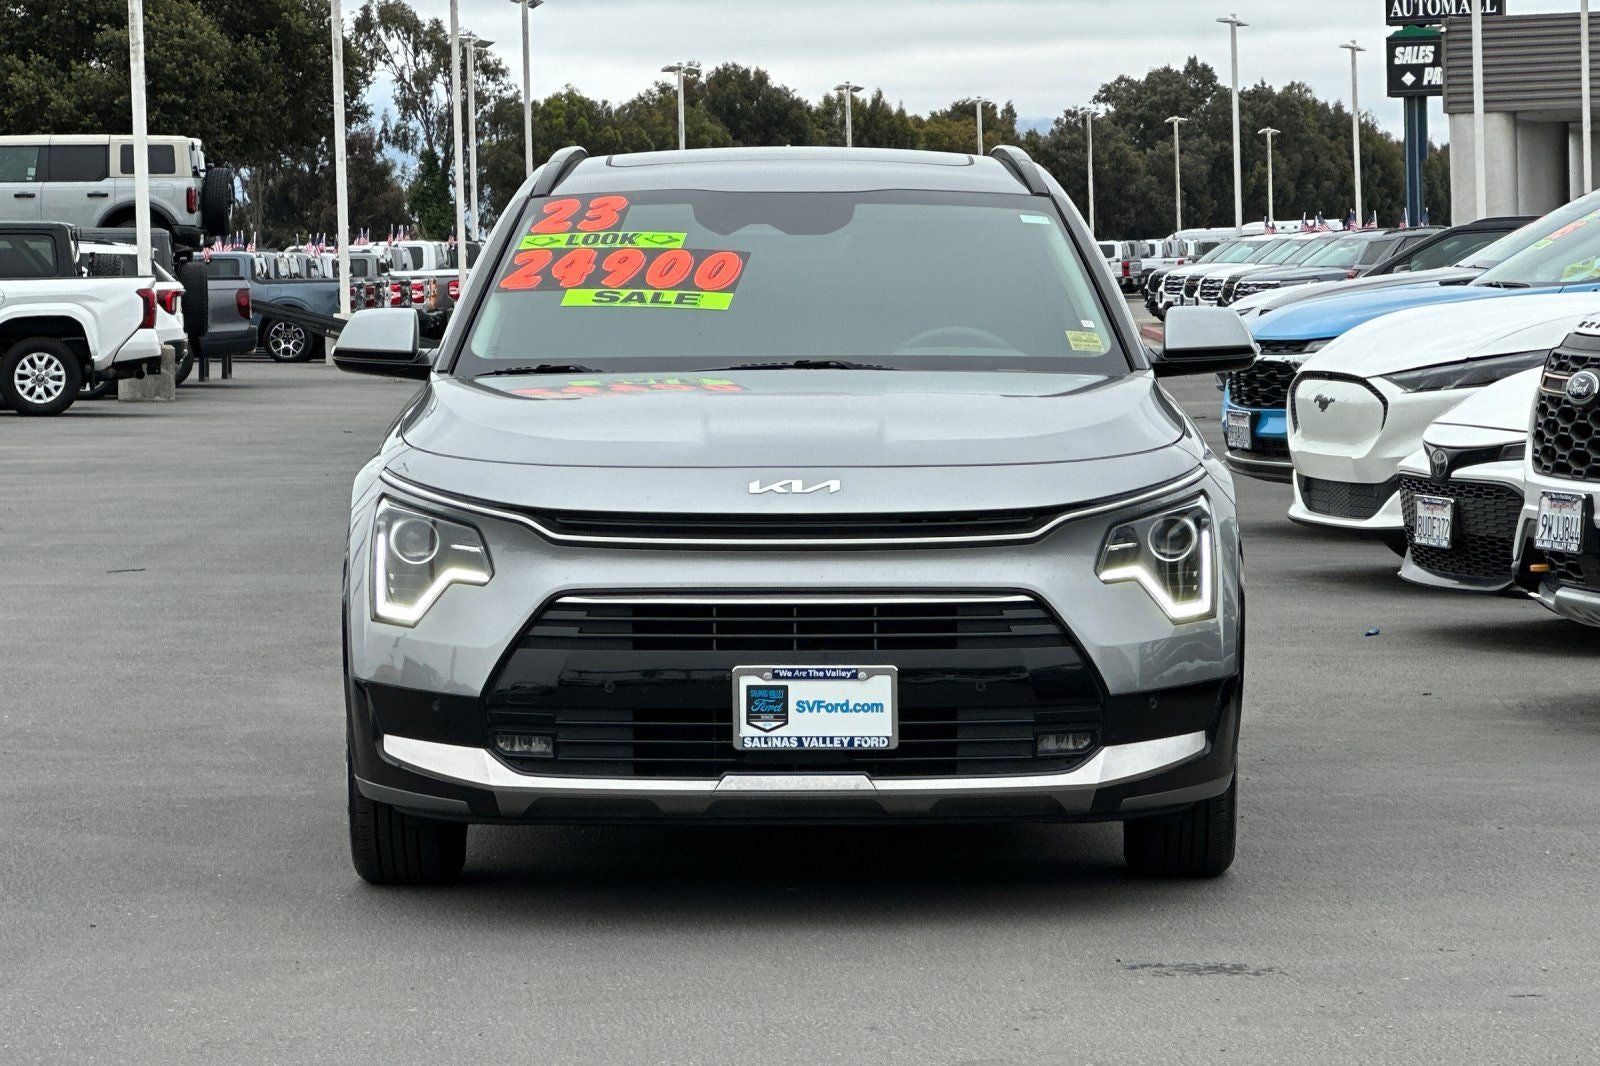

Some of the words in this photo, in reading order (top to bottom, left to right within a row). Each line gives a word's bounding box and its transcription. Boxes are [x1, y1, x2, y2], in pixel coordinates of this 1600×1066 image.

[1390, 0, 1497, 16] AUTOMAL
[1394, 45, 1435, 65] SALES
[1422, 66, 1443, 86] PA
[531, 196, 628, 233] 23
[565, 233, 643, 246] LOOK
[499, 248, 743, 290] 24900
[591, 291, 704, 307] SALE
[749, 479, 841, 494] KIA
[794, 669, 807, 677] Are
[808, 669, 825, 677] The
[751, 698, 784, 712] Ford
[795, 700, 884, 713] SVFord.com
[743, 737, 799, 748] SALINAS
[801, 737, 850, 748] VALLEY
[854, 737, 889, 748] FORD
